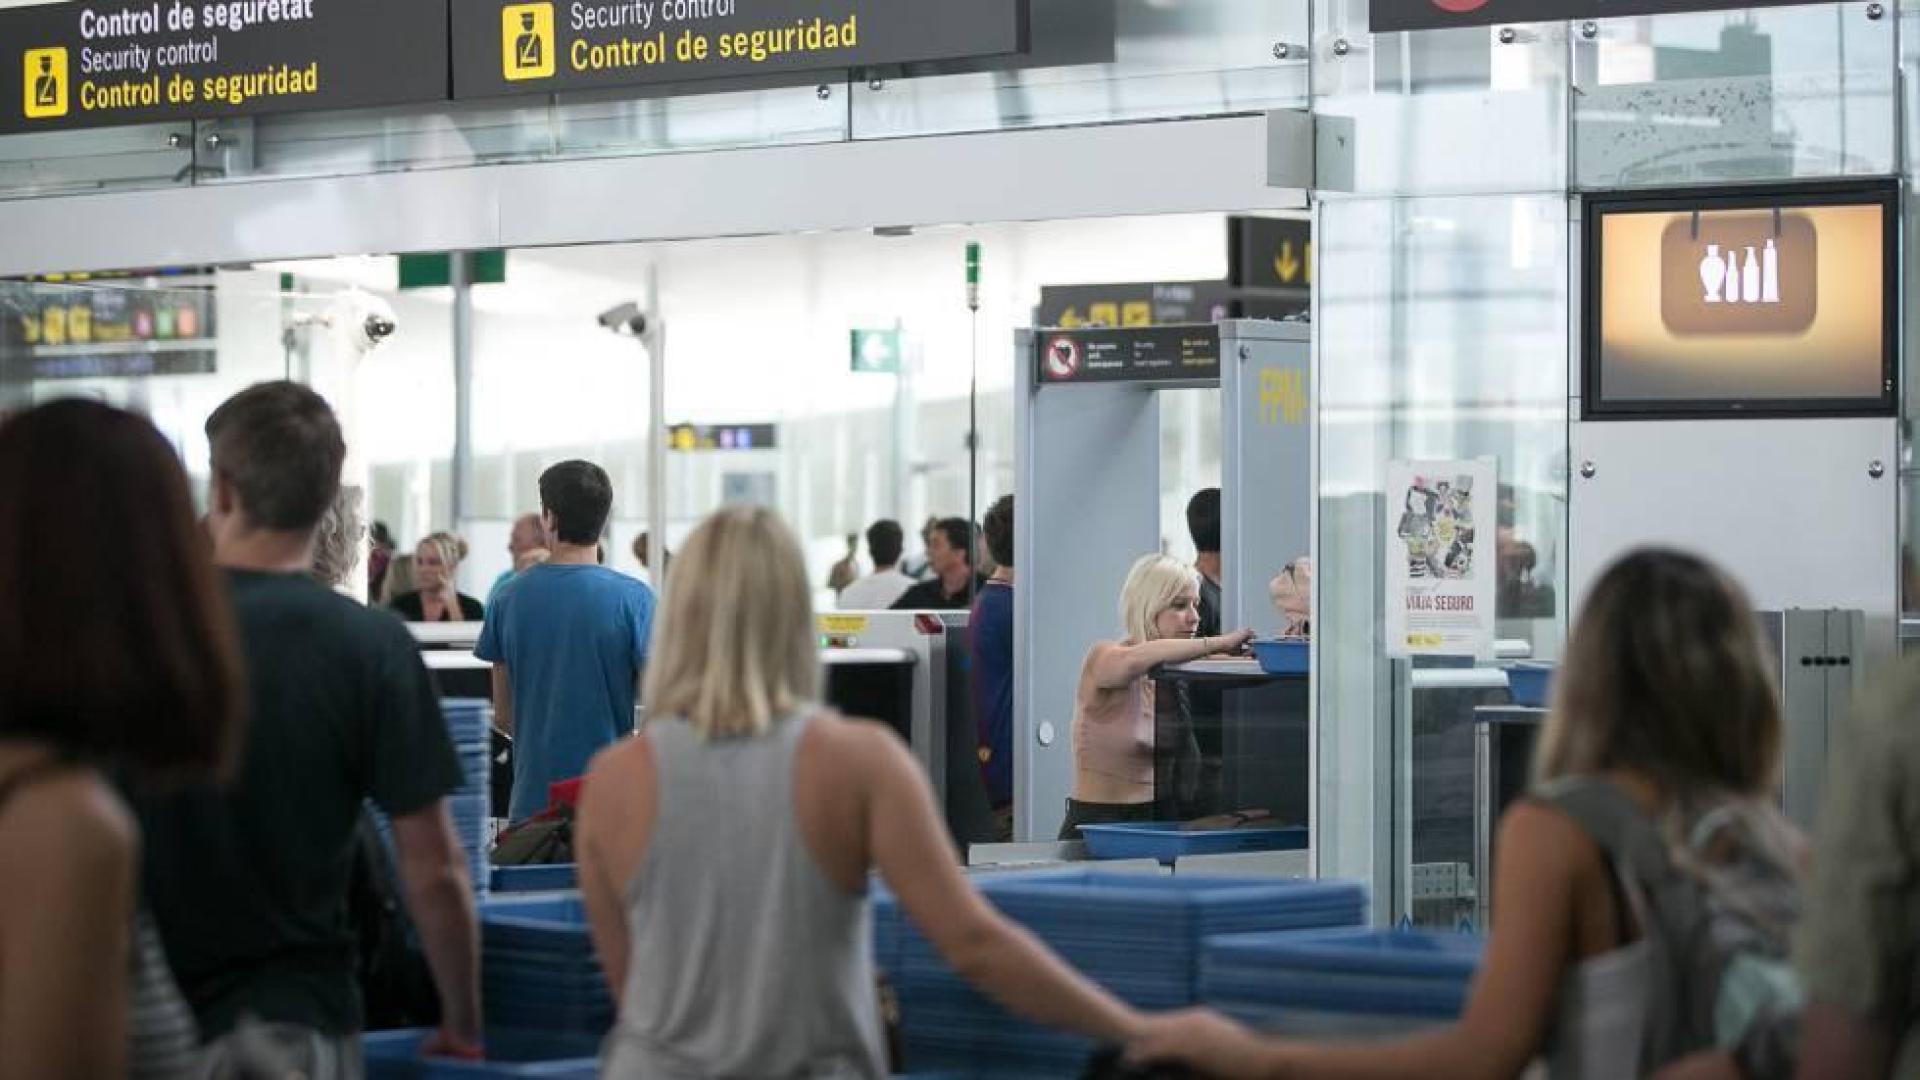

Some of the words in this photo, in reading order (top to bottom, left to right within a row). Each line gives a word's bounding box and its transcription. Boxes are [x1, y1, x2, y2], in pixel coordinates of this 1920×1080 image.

[80, 3, 159, 39] Control
[167, 0, 194, 31] de
[202, 0, 313, 31] seguretat
[571, 0, 653, 30] Security
[81, 42, 150, 73] Security
[157, 35, 217, 66] control
[571, 31, 665, 71] Control
[676, 29, 708, 61] de
[719, 15, 857, 61] seguridad
[80, 75, 160, 110] Control
[168, 73, 194, 103] de
[203, 62, 318, 104] seguridad
[1436, 595, 1473, 610] SEGURO
